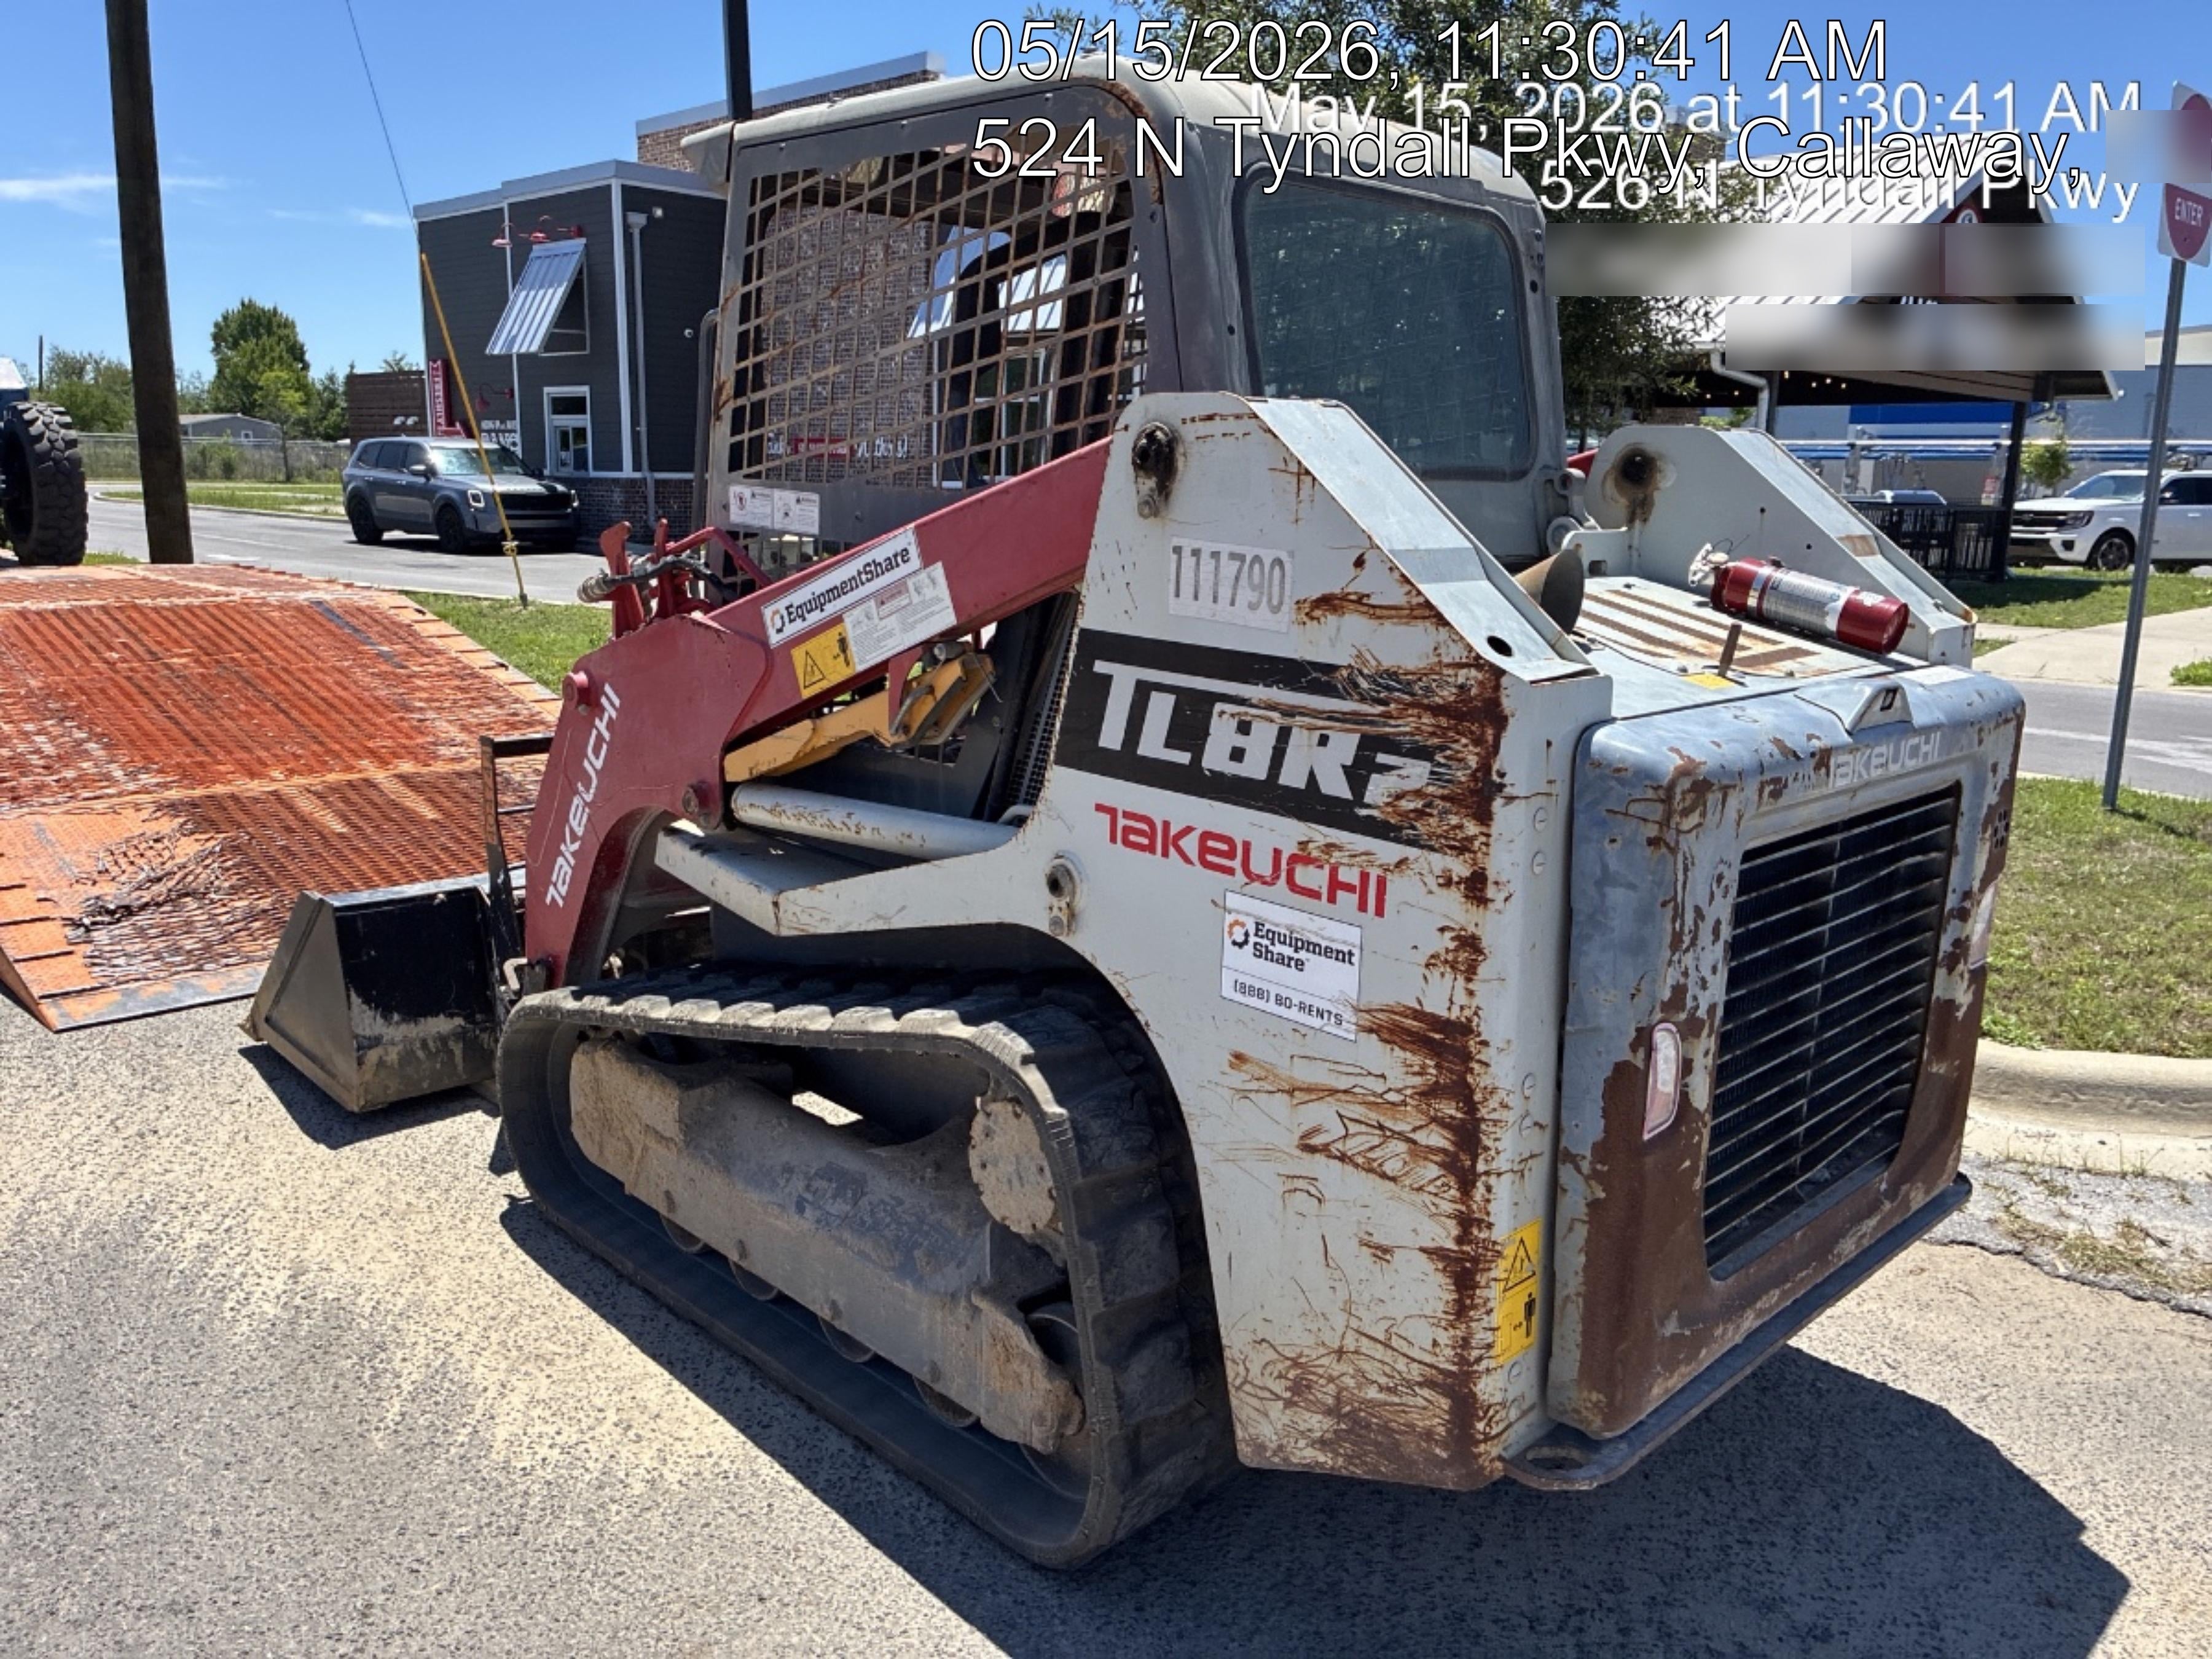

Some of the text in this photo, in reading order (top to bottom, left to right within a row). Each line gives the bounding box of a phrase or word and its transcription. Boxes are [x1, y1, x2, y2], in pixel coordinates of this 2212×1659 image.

[2175, 197, 2204, 227] ENTER
[784, 545, 911, 624] EquipmentShare
[1172, 545, 1287, 616] 111790
[1252, 941, 1306, 972] Share
[1253, 921, 1355, 967] Equipment
[1233, 978, 1271, 1003] (888)
